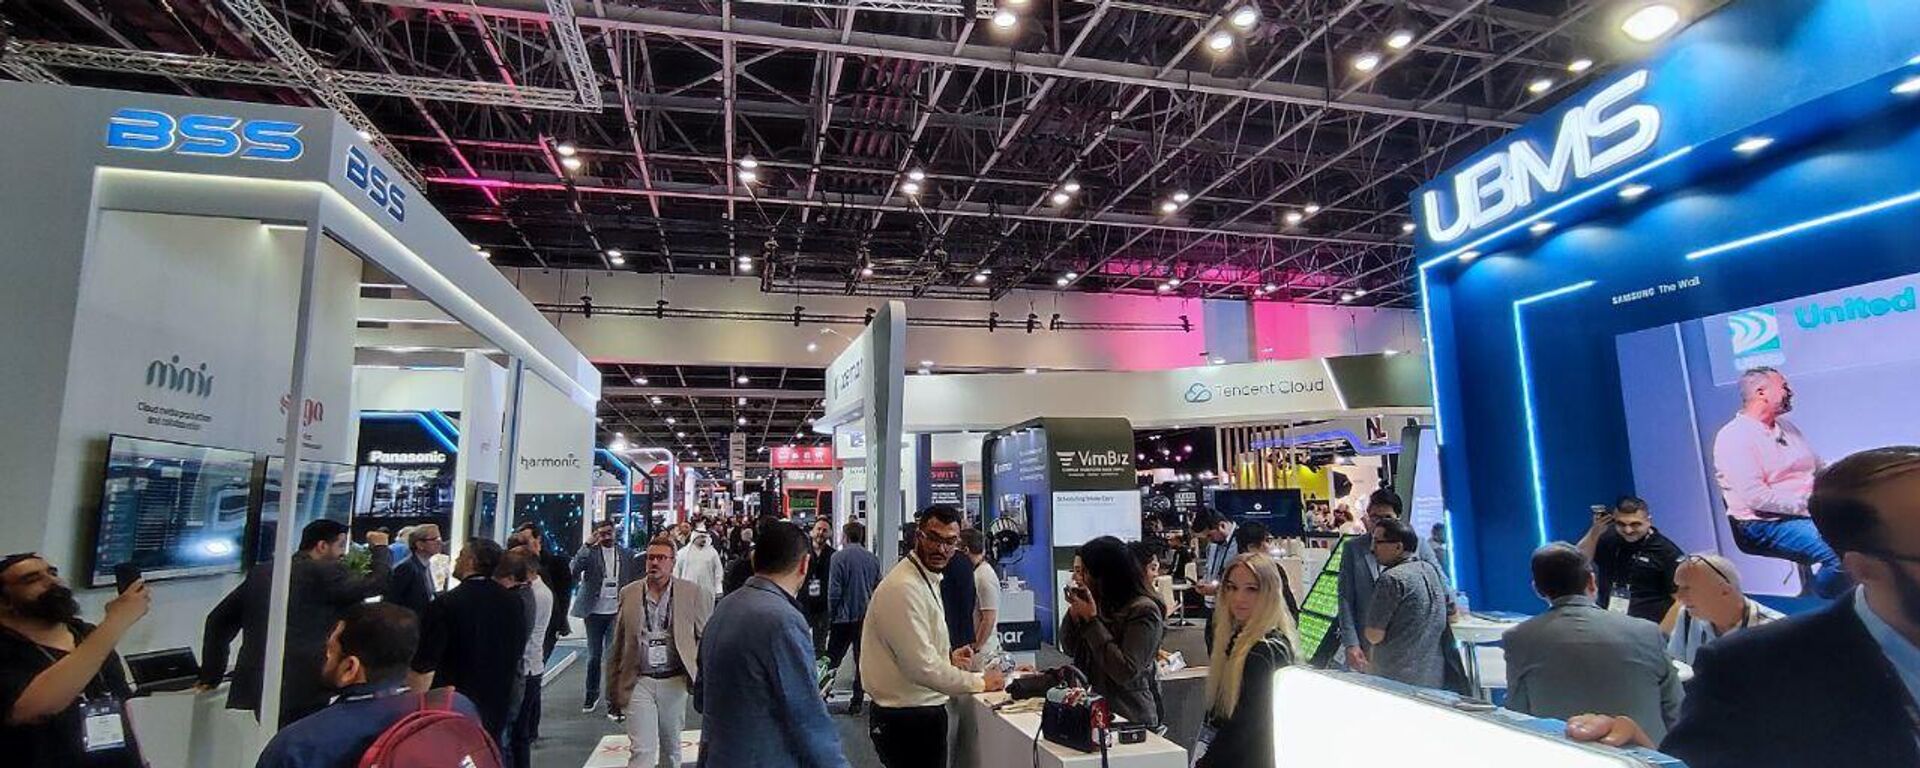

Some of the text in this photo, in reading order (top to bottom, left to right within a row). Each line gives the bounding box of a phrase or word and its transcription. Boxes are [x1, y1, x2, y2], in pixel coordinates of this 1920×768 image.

[106, 107, 304, 162] BSS
[1423, 69, 1661, 242] UBMS
[346, 144, 405, 223] BSS
[1612, 275, 1701, 305] SAMSUNG The Wall
[1794, 286, 1917, 329] United
[1215, 379, 1324, 398] Tencent Cloud
[369, 450, 446, 465] Panasonic
[520, 452, 580, 471] harmonic
[1077, 449, 1130, 467] VimBiz
